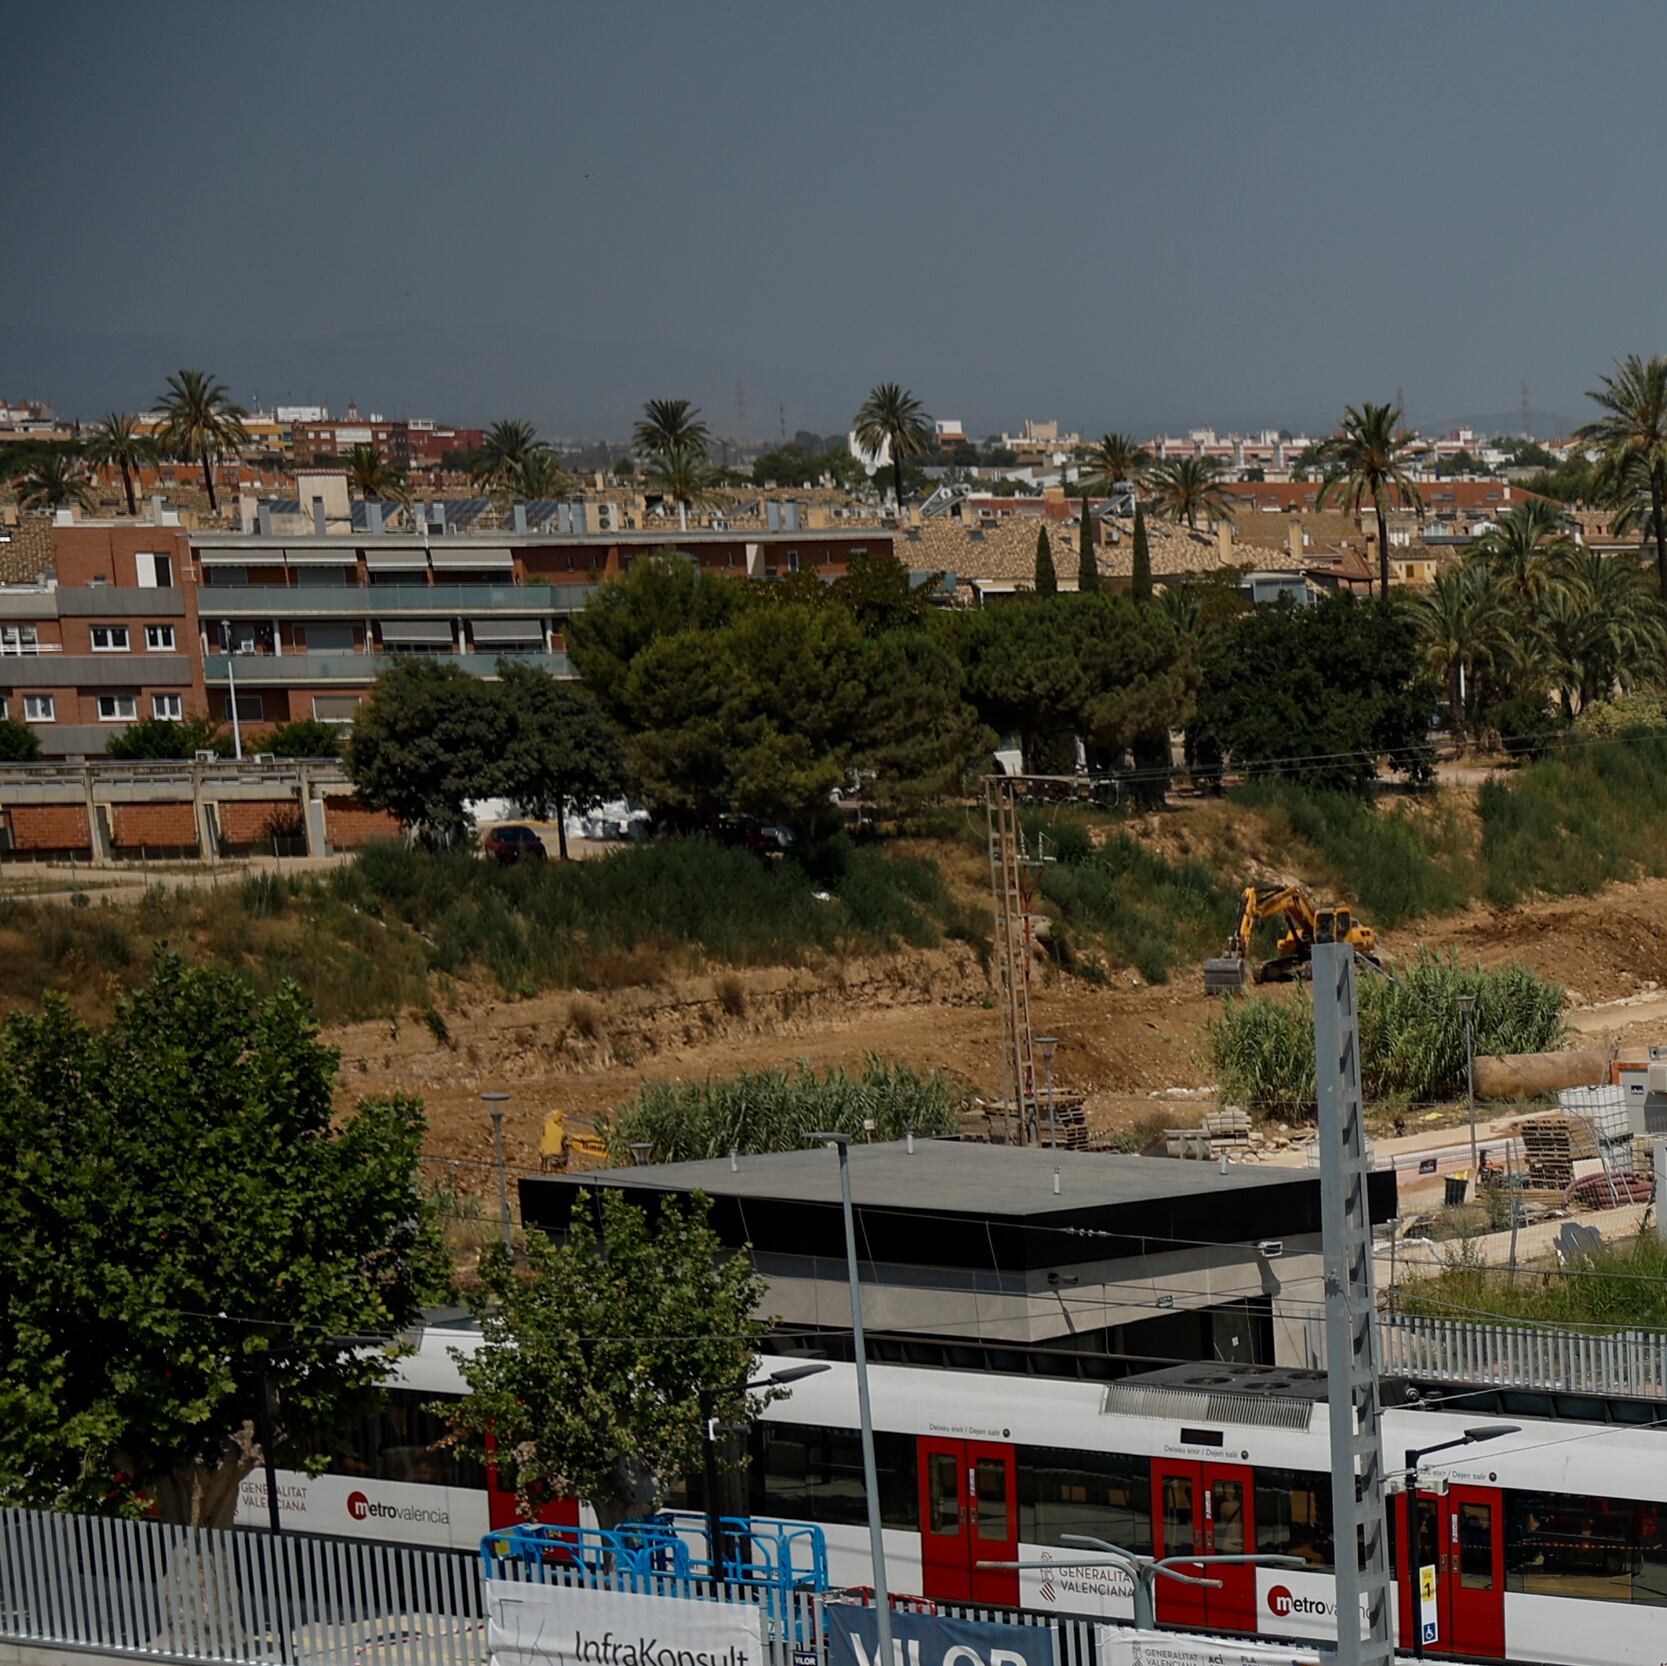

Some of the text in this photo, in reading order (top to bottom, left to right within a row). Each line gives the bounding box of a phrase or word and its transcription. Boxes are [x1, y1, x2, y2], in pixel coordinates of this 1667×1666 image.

[241, 1482, 307, 1498] GENEALITAT
[242, 1496, 306, 1512] VALECIANA
[355, 1501, 450, 1525] metrovalencia
[1059, 1565, 1131, 1583] GENERALITA
[1060, 1583, 1135, 1598] VALENCIANA
[1424, 1582, 1431, 1598] 1
[794, 1655, 816, 1666] VILOR
[1145, 1649, 1198, 1661] GENERALITAT
